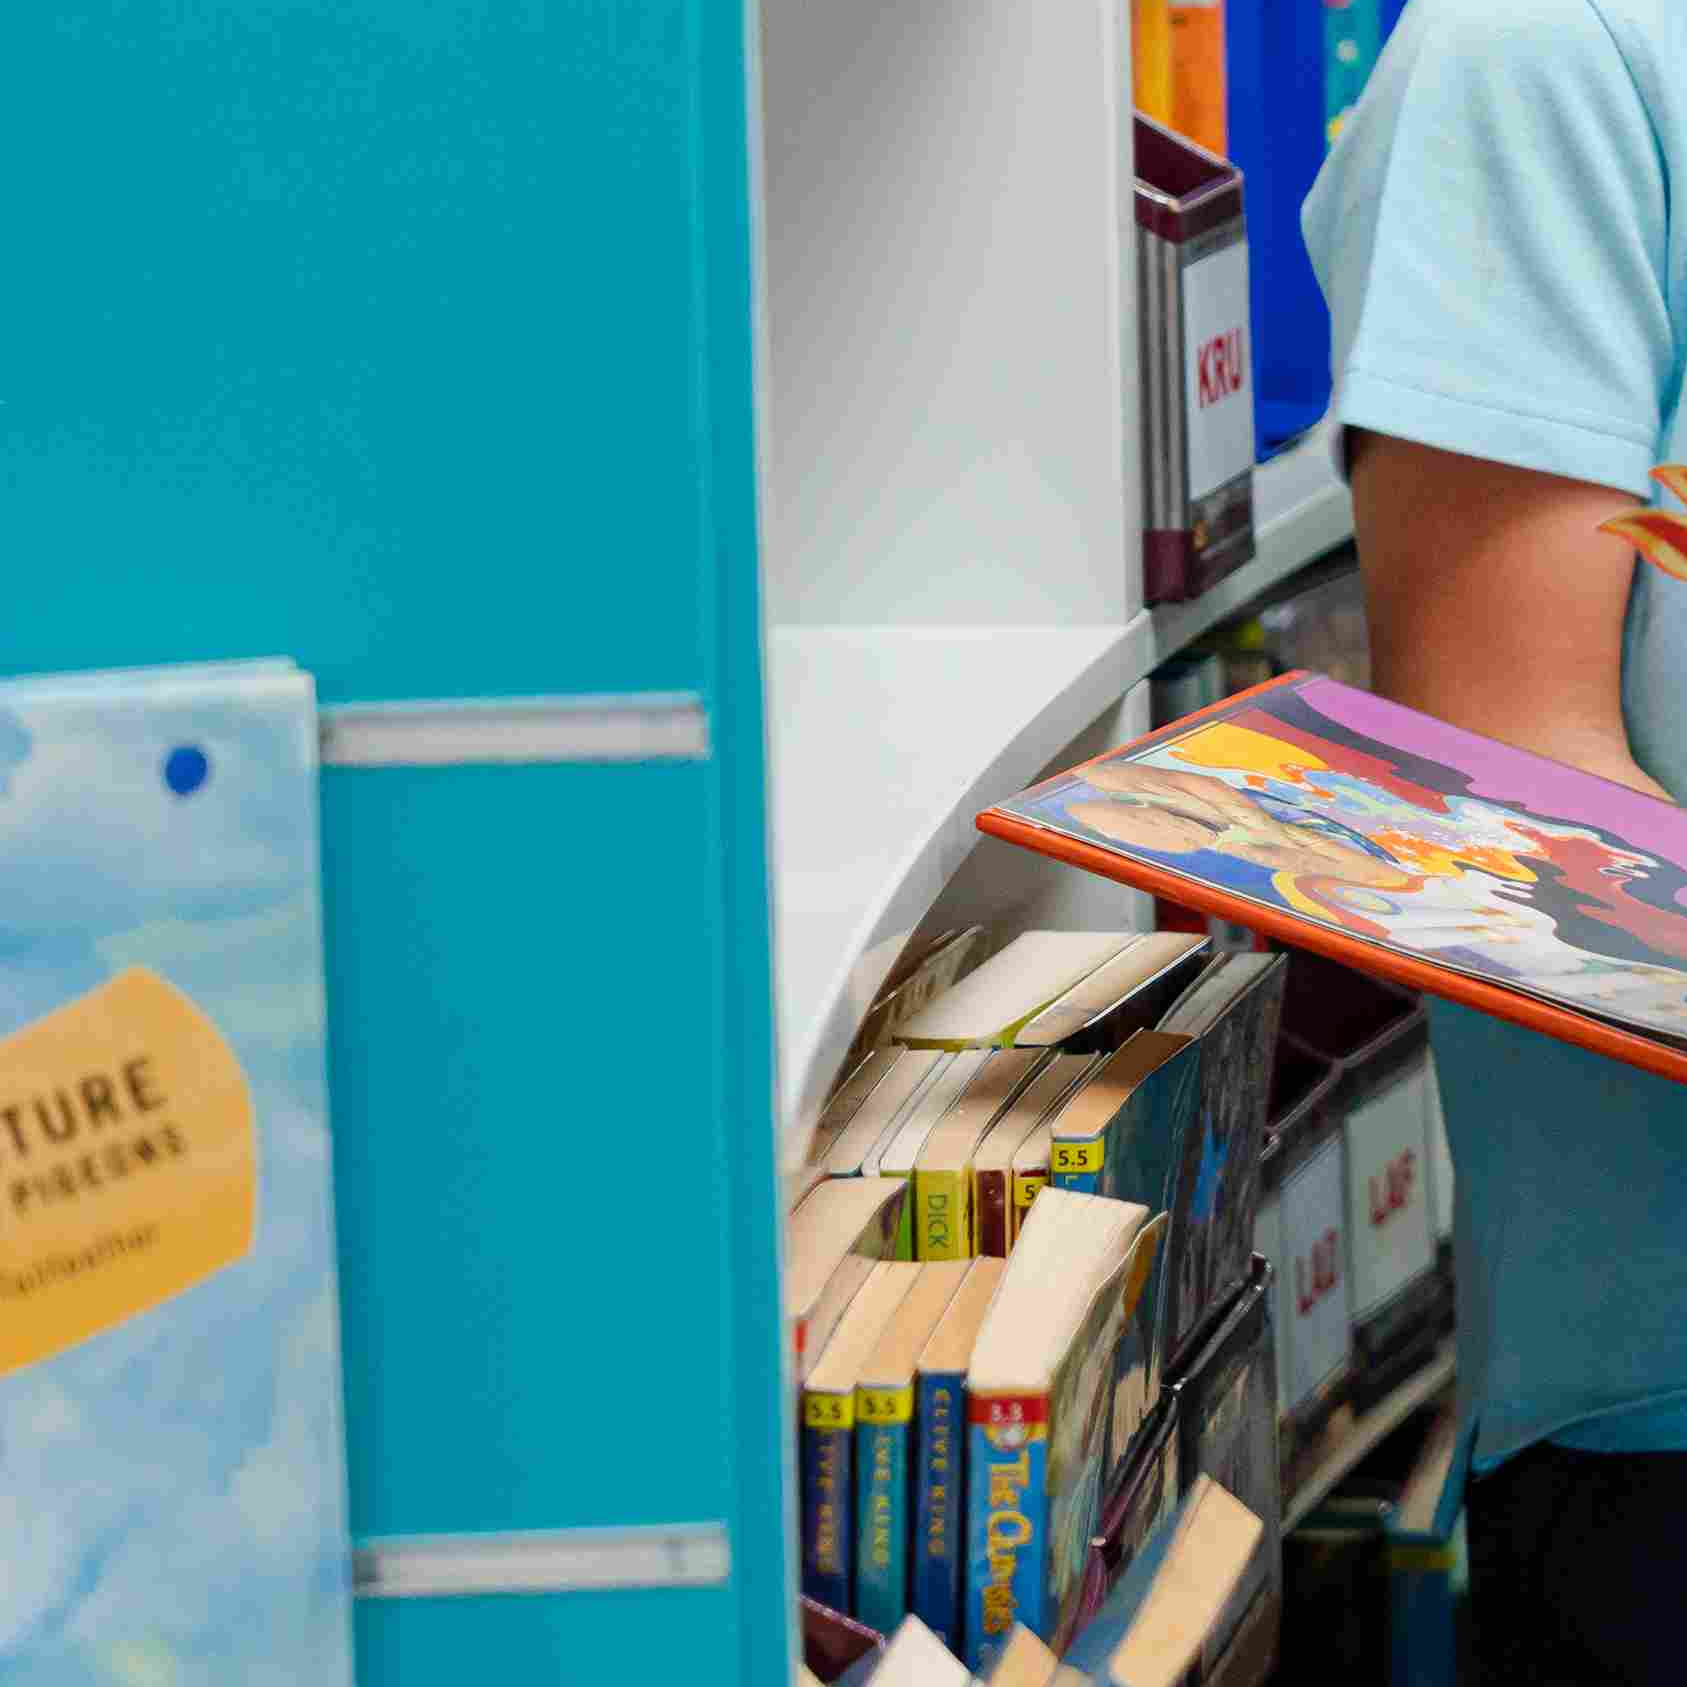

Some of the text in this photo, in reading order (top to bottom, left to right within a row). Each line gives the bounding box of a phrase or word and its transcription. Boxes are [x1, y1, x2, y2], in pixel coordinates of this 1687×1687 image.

[1197, 328, 1242, 409] KRU
[1057, 1149, 1089, 1167] 5.5
[927, 1192, 950, 1250] DICK
[810, 1400, 842, 1421] 5.5
[866, 1393, 898, 1414] 5.5
[927, 1388, 951, 1556] CLIVE KING
